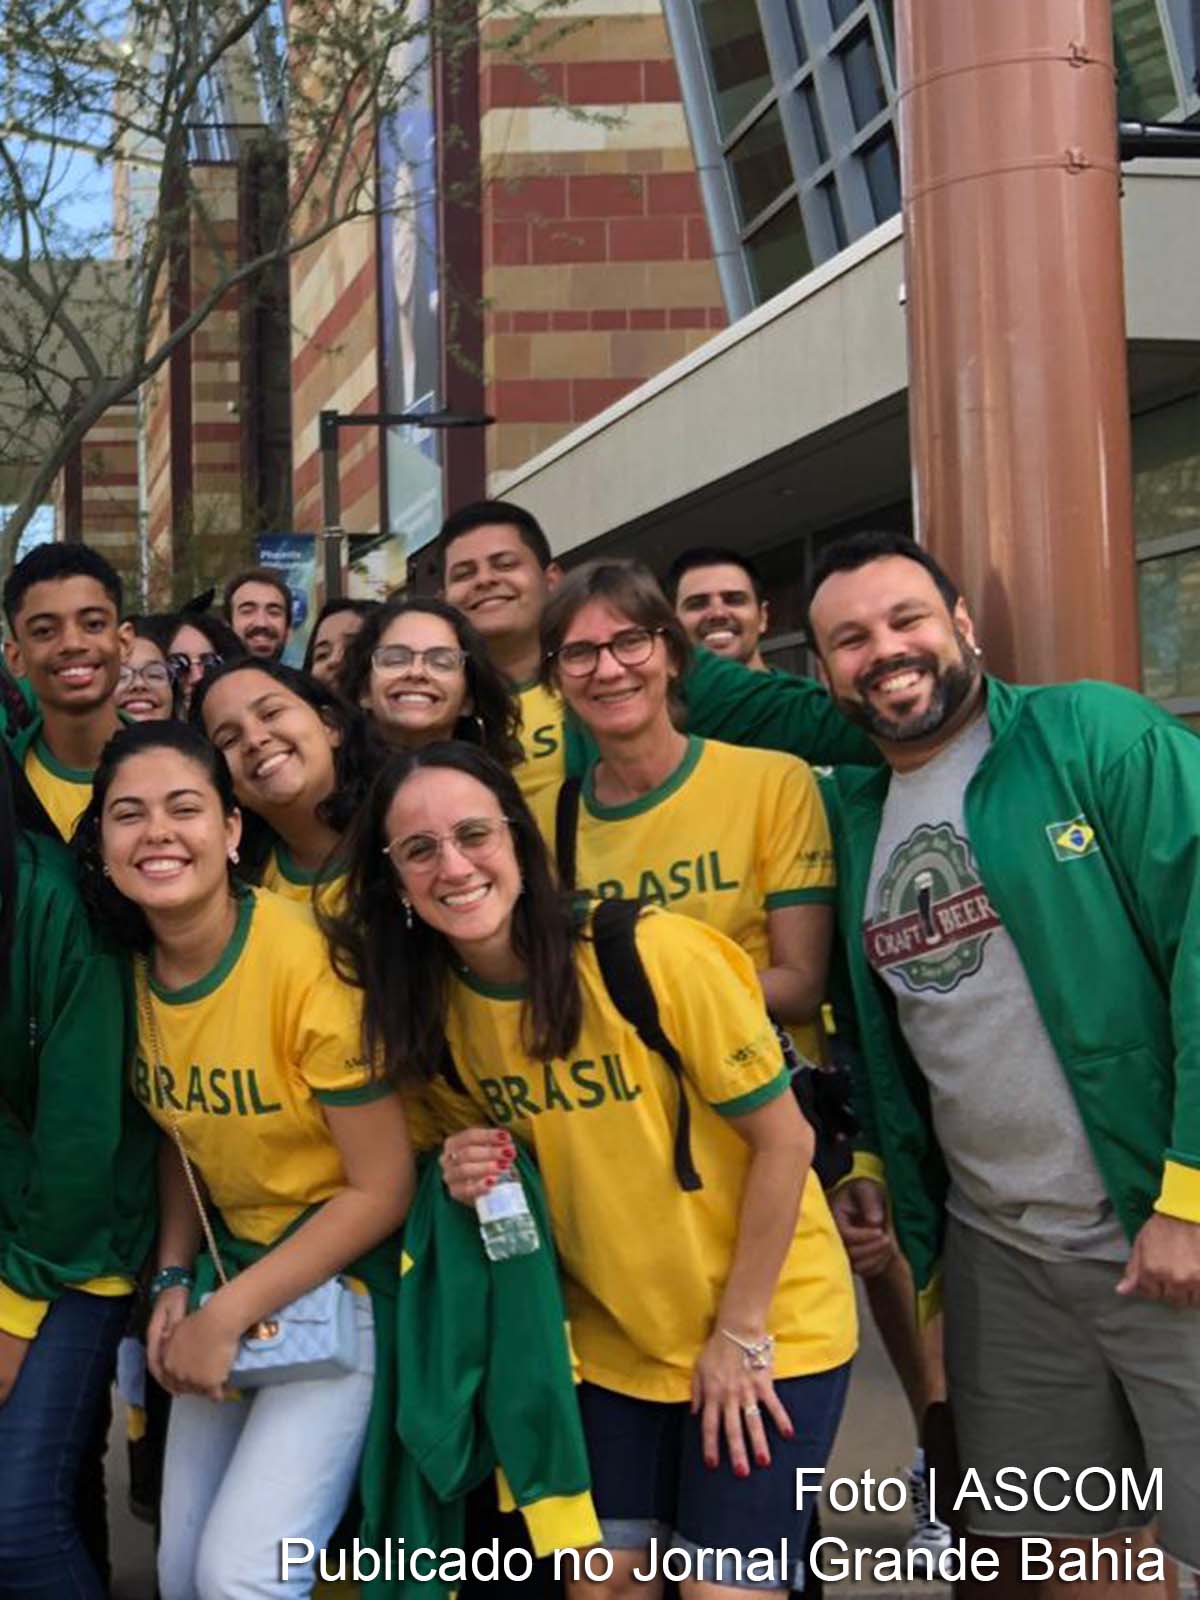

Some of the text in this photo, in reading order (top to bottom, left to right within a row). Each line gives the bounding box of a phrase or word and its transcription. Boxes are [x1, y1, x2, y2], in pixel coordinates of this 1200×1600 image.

[873, 894, 992, 957] CRAFT BEER
[132, 1056, 283, 1116] BRASIL
[479, 1053, 642, 1123] BRASIL
